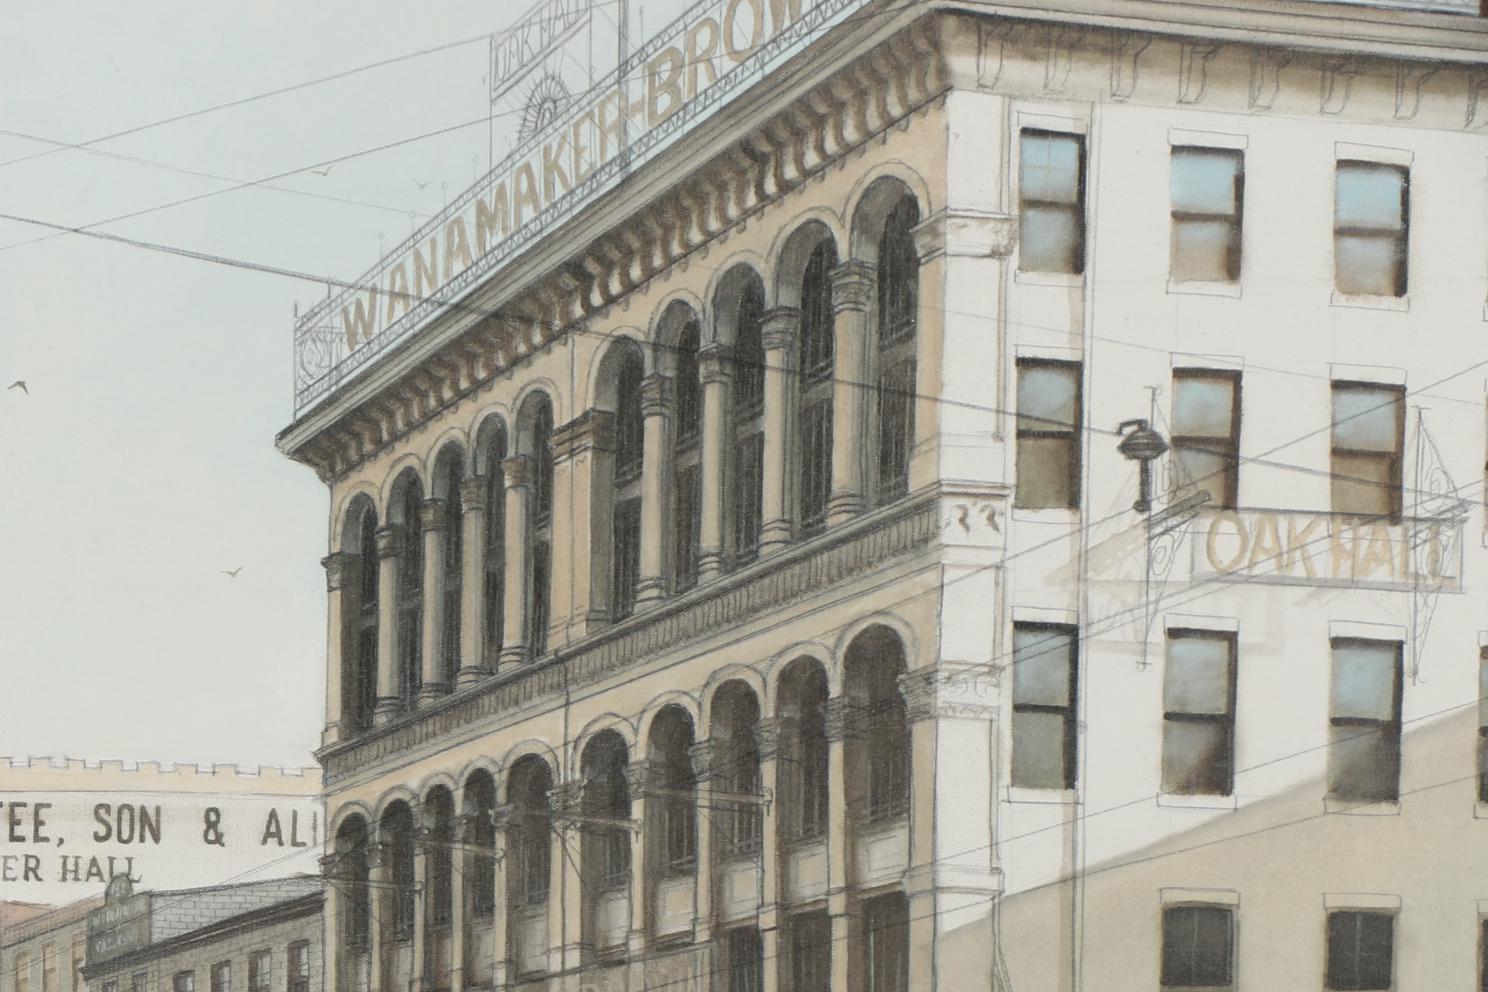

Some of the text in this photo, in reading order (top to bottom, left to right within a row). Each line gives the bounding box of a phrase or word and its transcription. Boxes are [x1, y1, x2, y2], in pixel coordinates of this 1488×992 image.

[1206, 511, 1320, 578] OAK
[92, 803, 162, 845] SON
[202, 806, 226, 848] &
[58, 854, 143, 883] HALL
